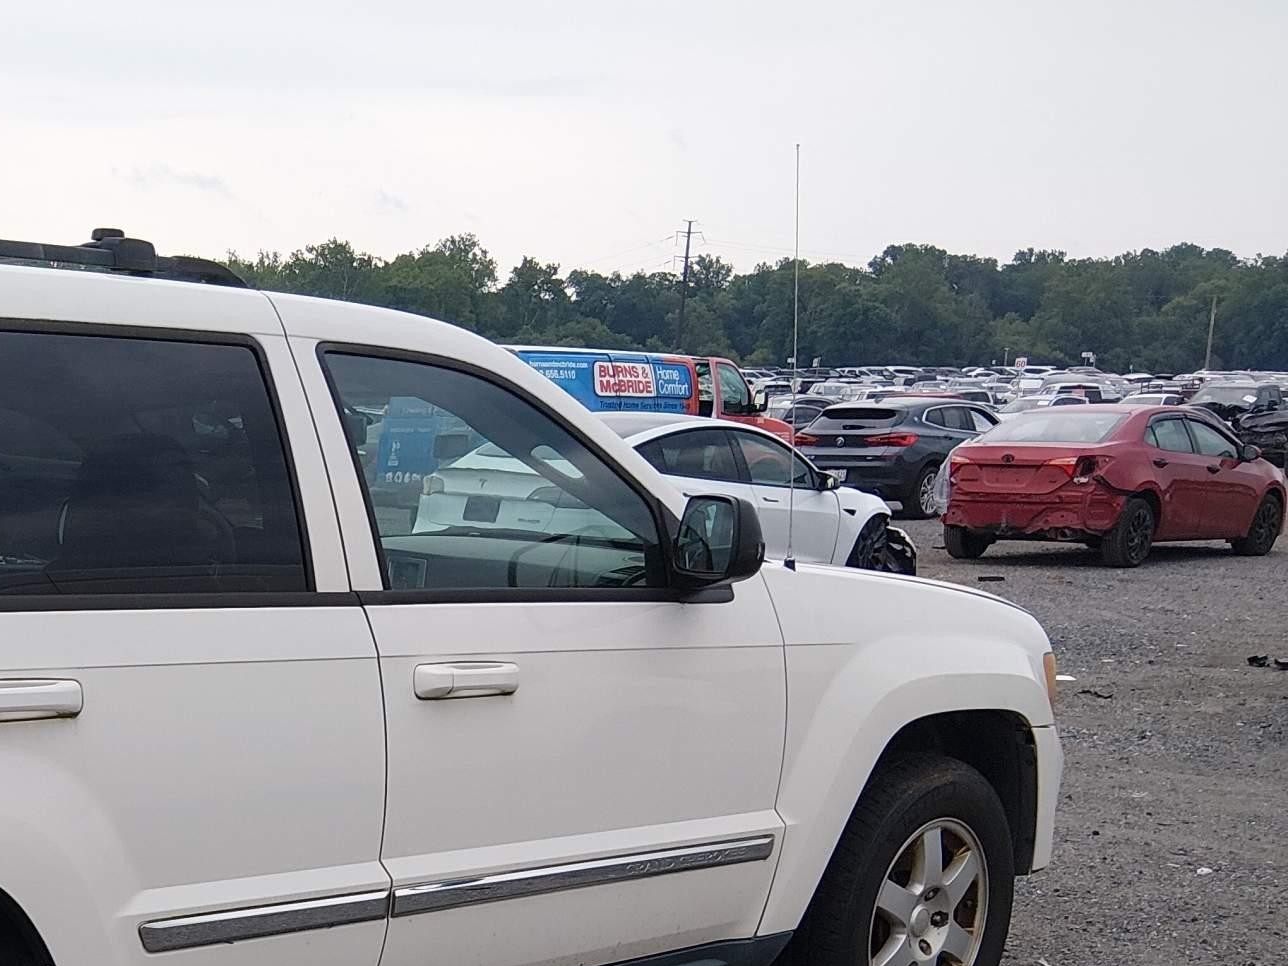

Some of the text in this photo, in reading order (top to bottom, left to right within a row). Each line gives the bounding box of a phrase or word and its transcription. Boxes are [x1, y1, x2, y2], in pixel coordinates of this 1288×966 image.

[598, 365, 649, 379] BURNS &
[656, 366, 680, 380] Home
[599, 380, 653, 394] McBRIDE
[658, 380, 689, 396] Comfort
